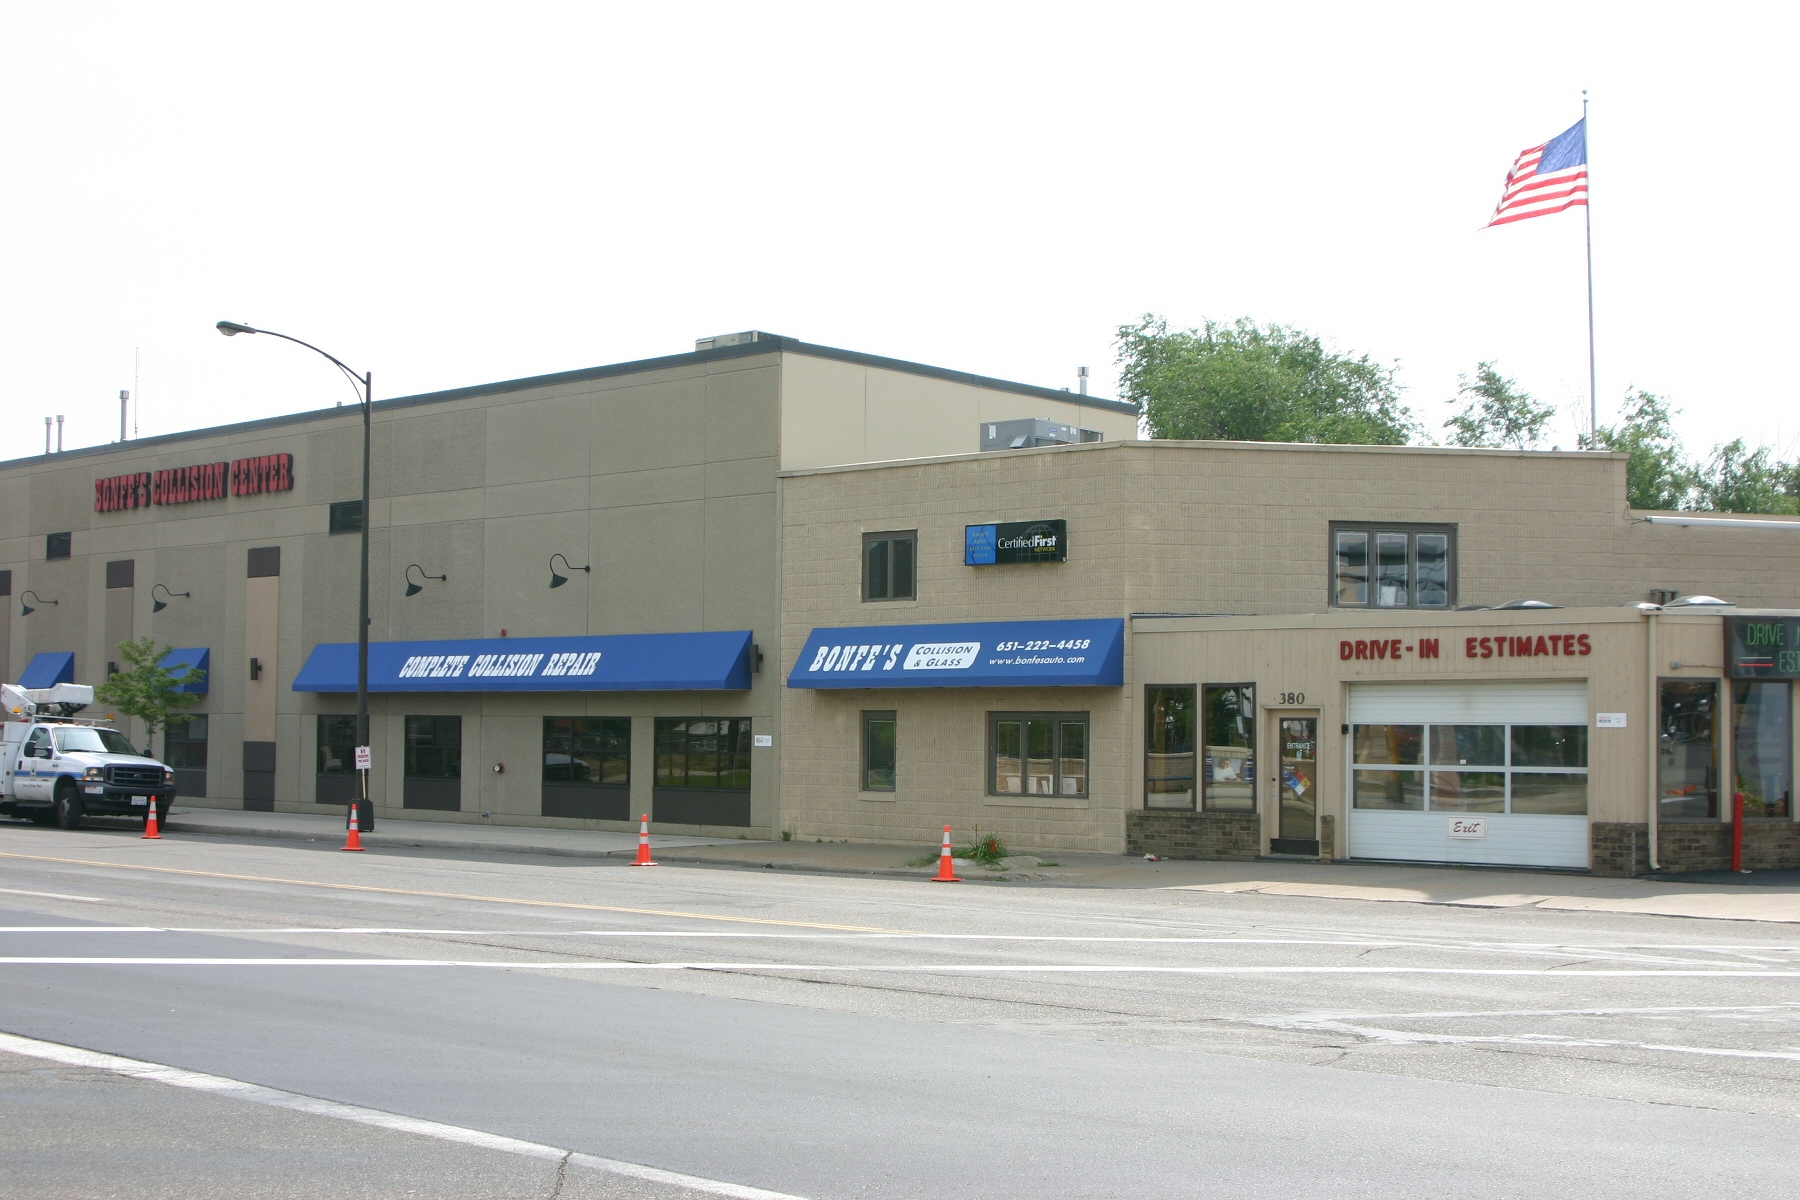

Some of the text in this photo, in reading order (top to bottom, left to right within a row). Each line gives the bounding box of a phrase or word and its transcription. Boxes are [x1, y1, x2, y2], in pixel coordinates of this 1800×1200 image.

[95, 453, 293, 512] BONFE'S COLLISION CENTER
[1746, 623, 1784, 645] DRIVE
[915, 645, 974, 655] COLLISION
[996, 639, 1091, 651] 651-222-4458
[1340, 634, 1592, 660] DRIVE-IN ESTIMATES
[808, 644, 903, 672] BONFE'S
[913, 658, 963, 667] & GLASS
[989, 655, 1085, 665] www.bonfesauto.com
[399, 653, 601, 678] COMPLETE COLLISION REPAIR
[1279, 692, 1305, 704] 380
[1286, 742, 1311, 750] ENTRANCE
[1453, 821, 1481, 833] Exit
